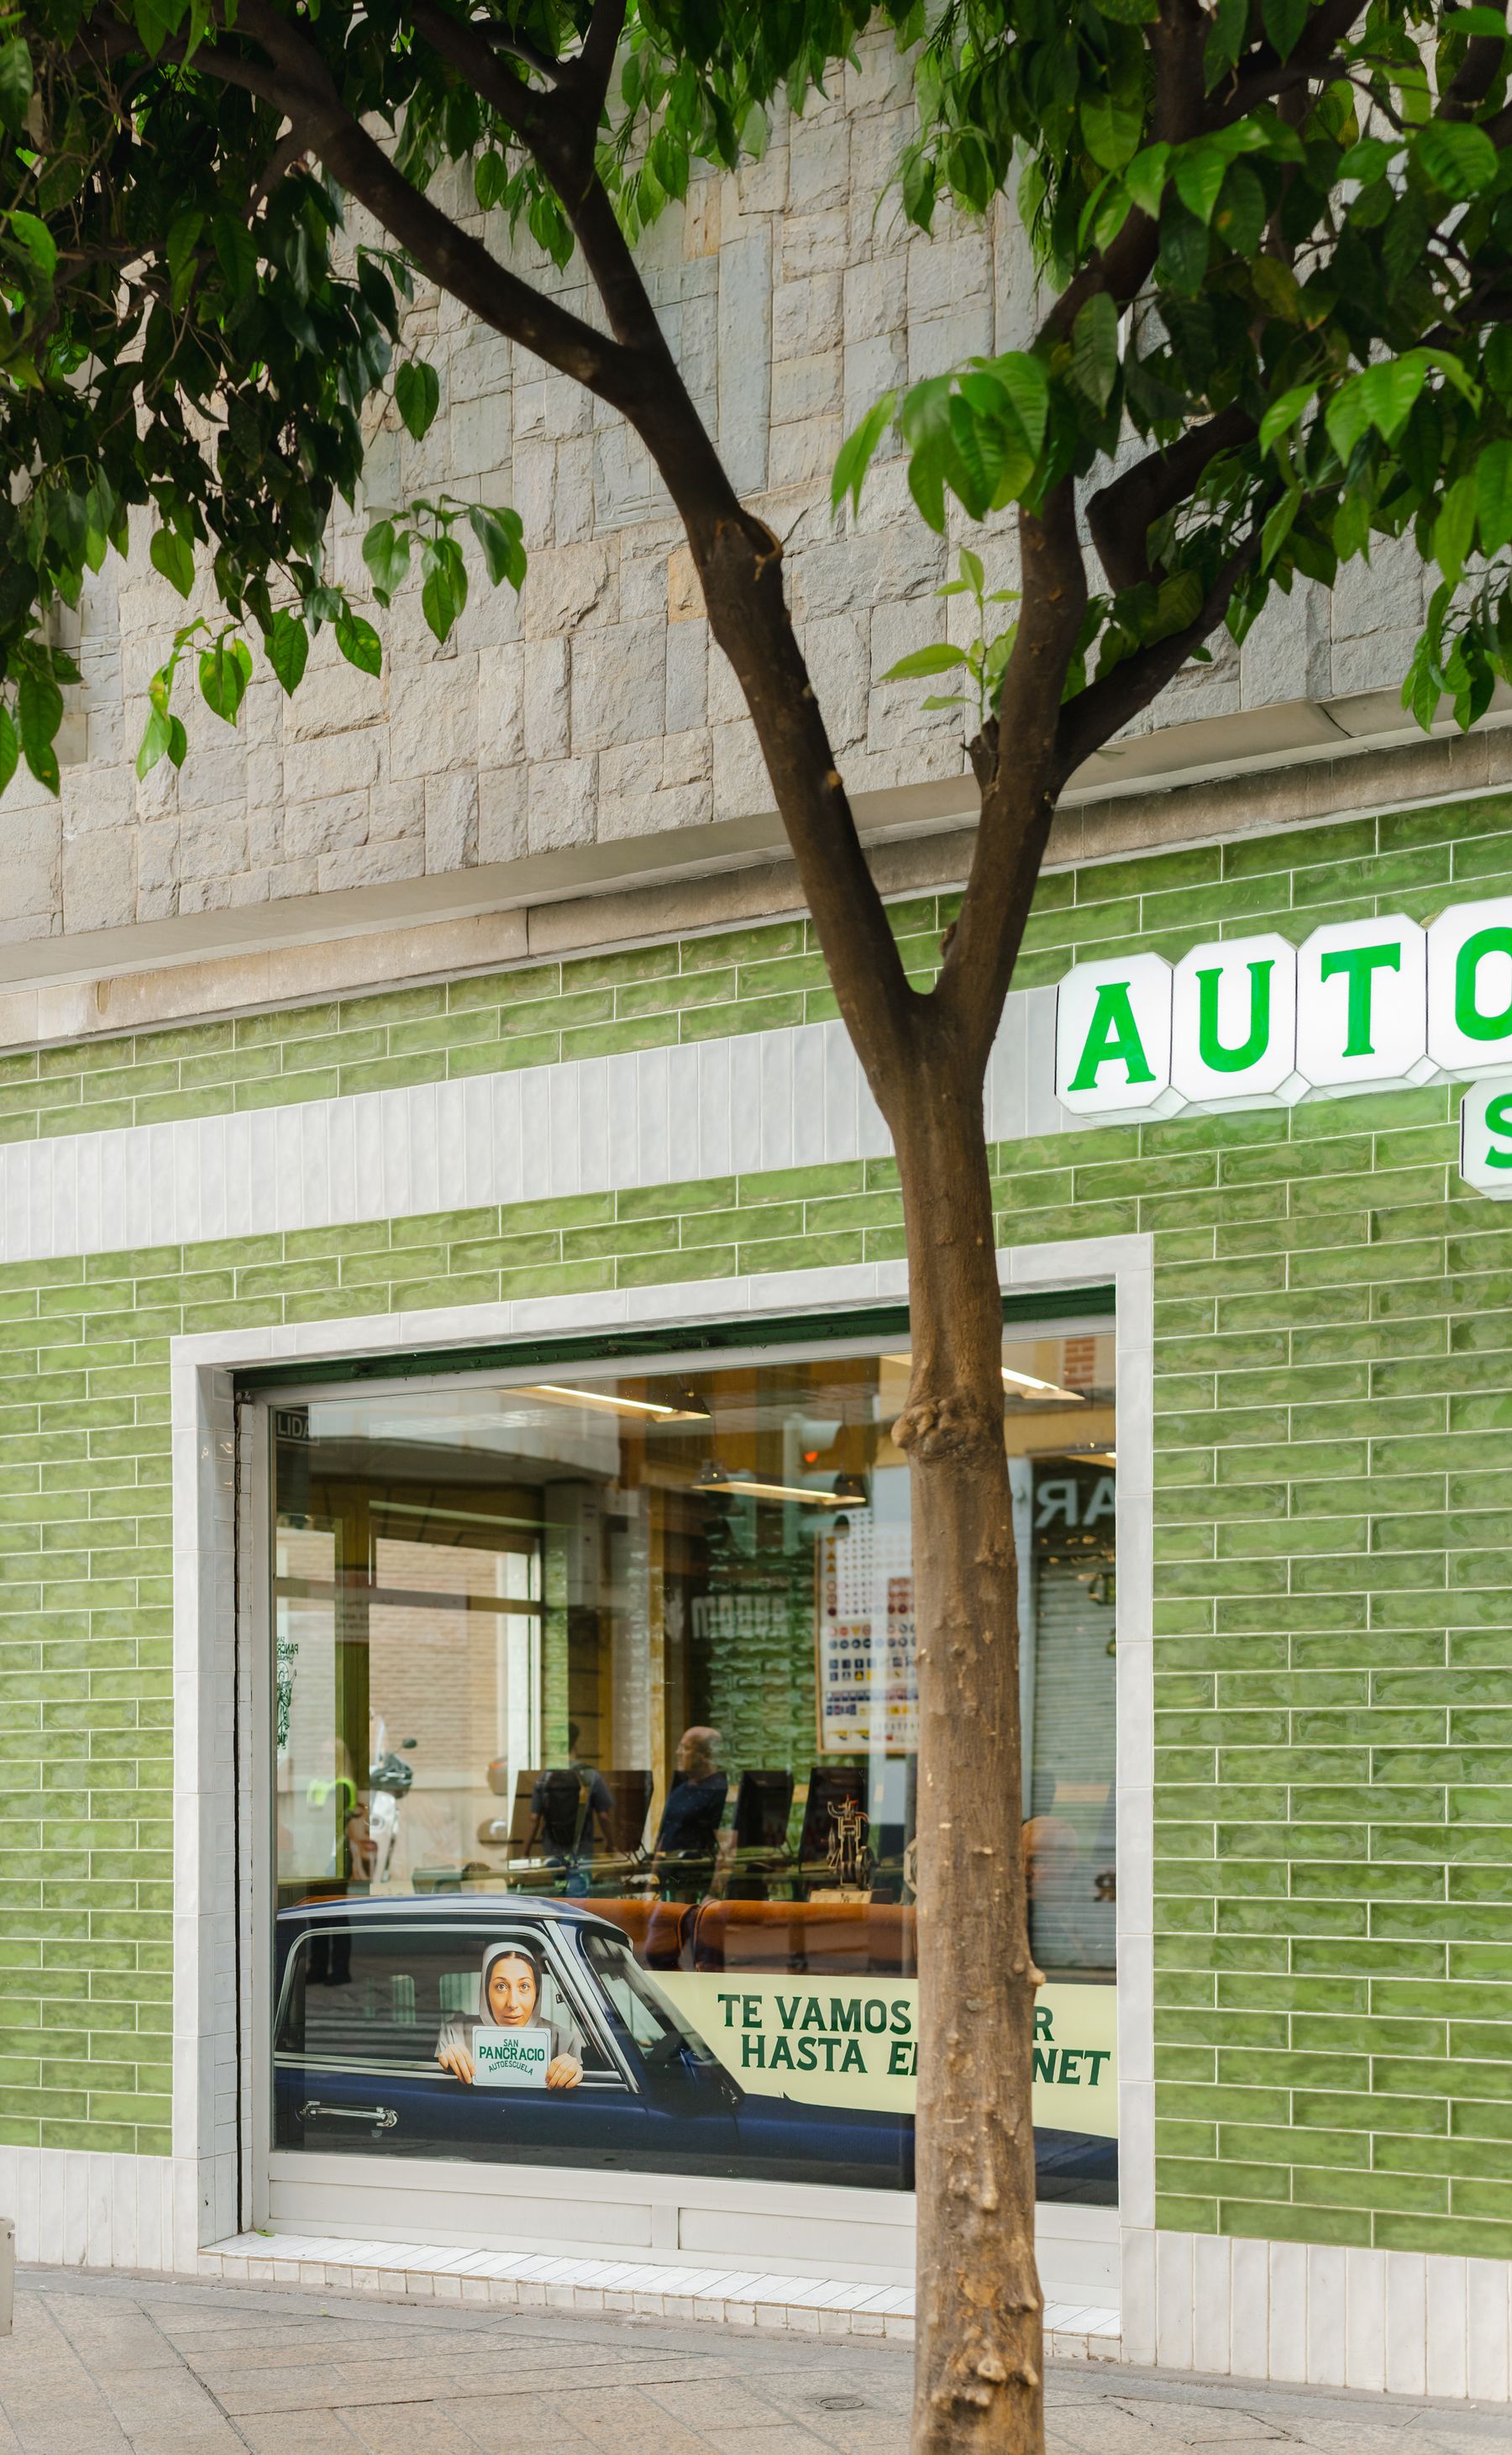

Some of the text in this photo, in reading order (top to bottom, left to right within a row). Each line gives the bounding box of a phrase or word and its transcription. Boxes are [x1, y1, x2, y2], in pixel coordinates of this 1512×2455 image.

[1068, 926, 1512, 1091] AUTO
[717, 1994, 762, 2029] TE
[774, 1995, 911, 2036] VAMOS
[479, 2046, 545, 2062] PANCRACIO
[503, 2038, 519, 2048] SAN
[488, 2059, 533, 2076] AUTOESCUELA
[741, 2034, 869, 2074] HASTA
[1032, 2048, 1110, 2086] NET
